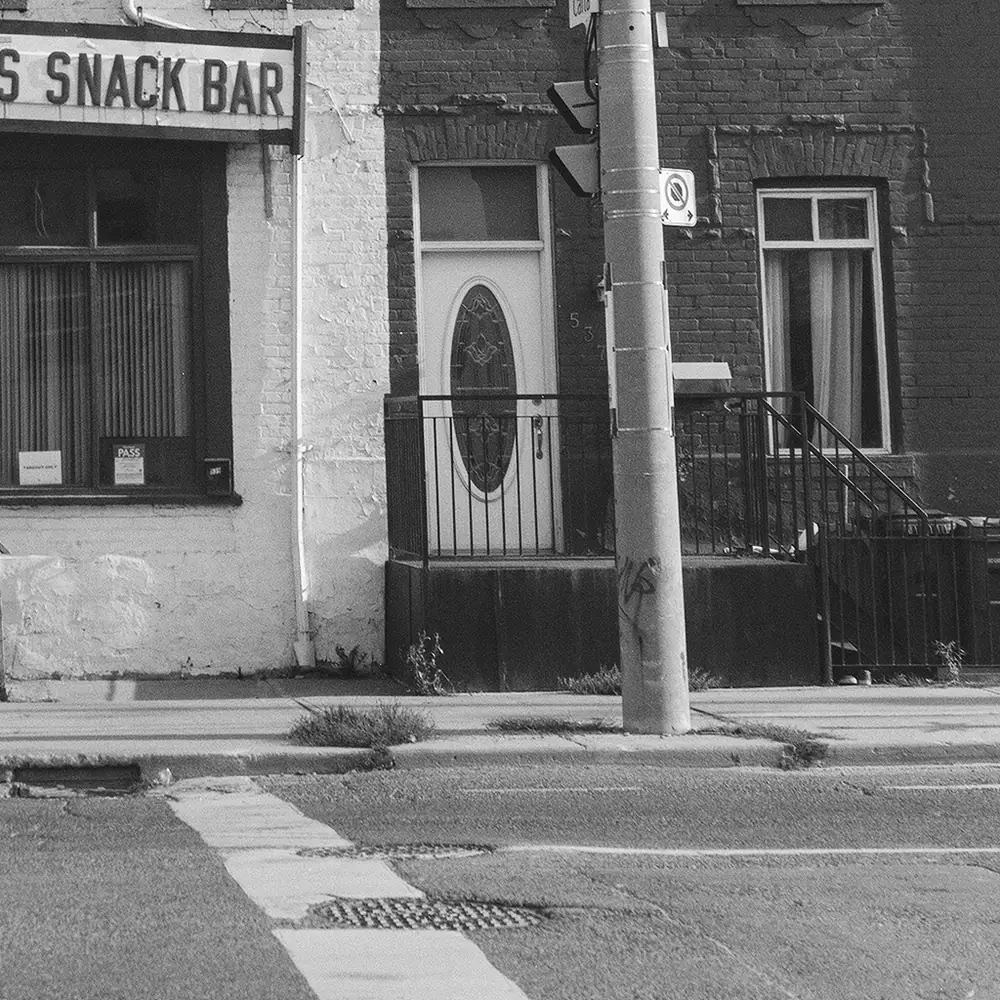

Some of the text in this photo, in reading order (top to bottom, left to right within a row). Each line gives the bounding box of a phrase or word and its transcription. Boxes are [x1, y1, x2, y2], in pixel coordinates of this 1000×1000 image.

[45, 50, 187, 111] SNACK
[202, 58, 285, 116] BAR
[118, 448, 141, 458] PASS
